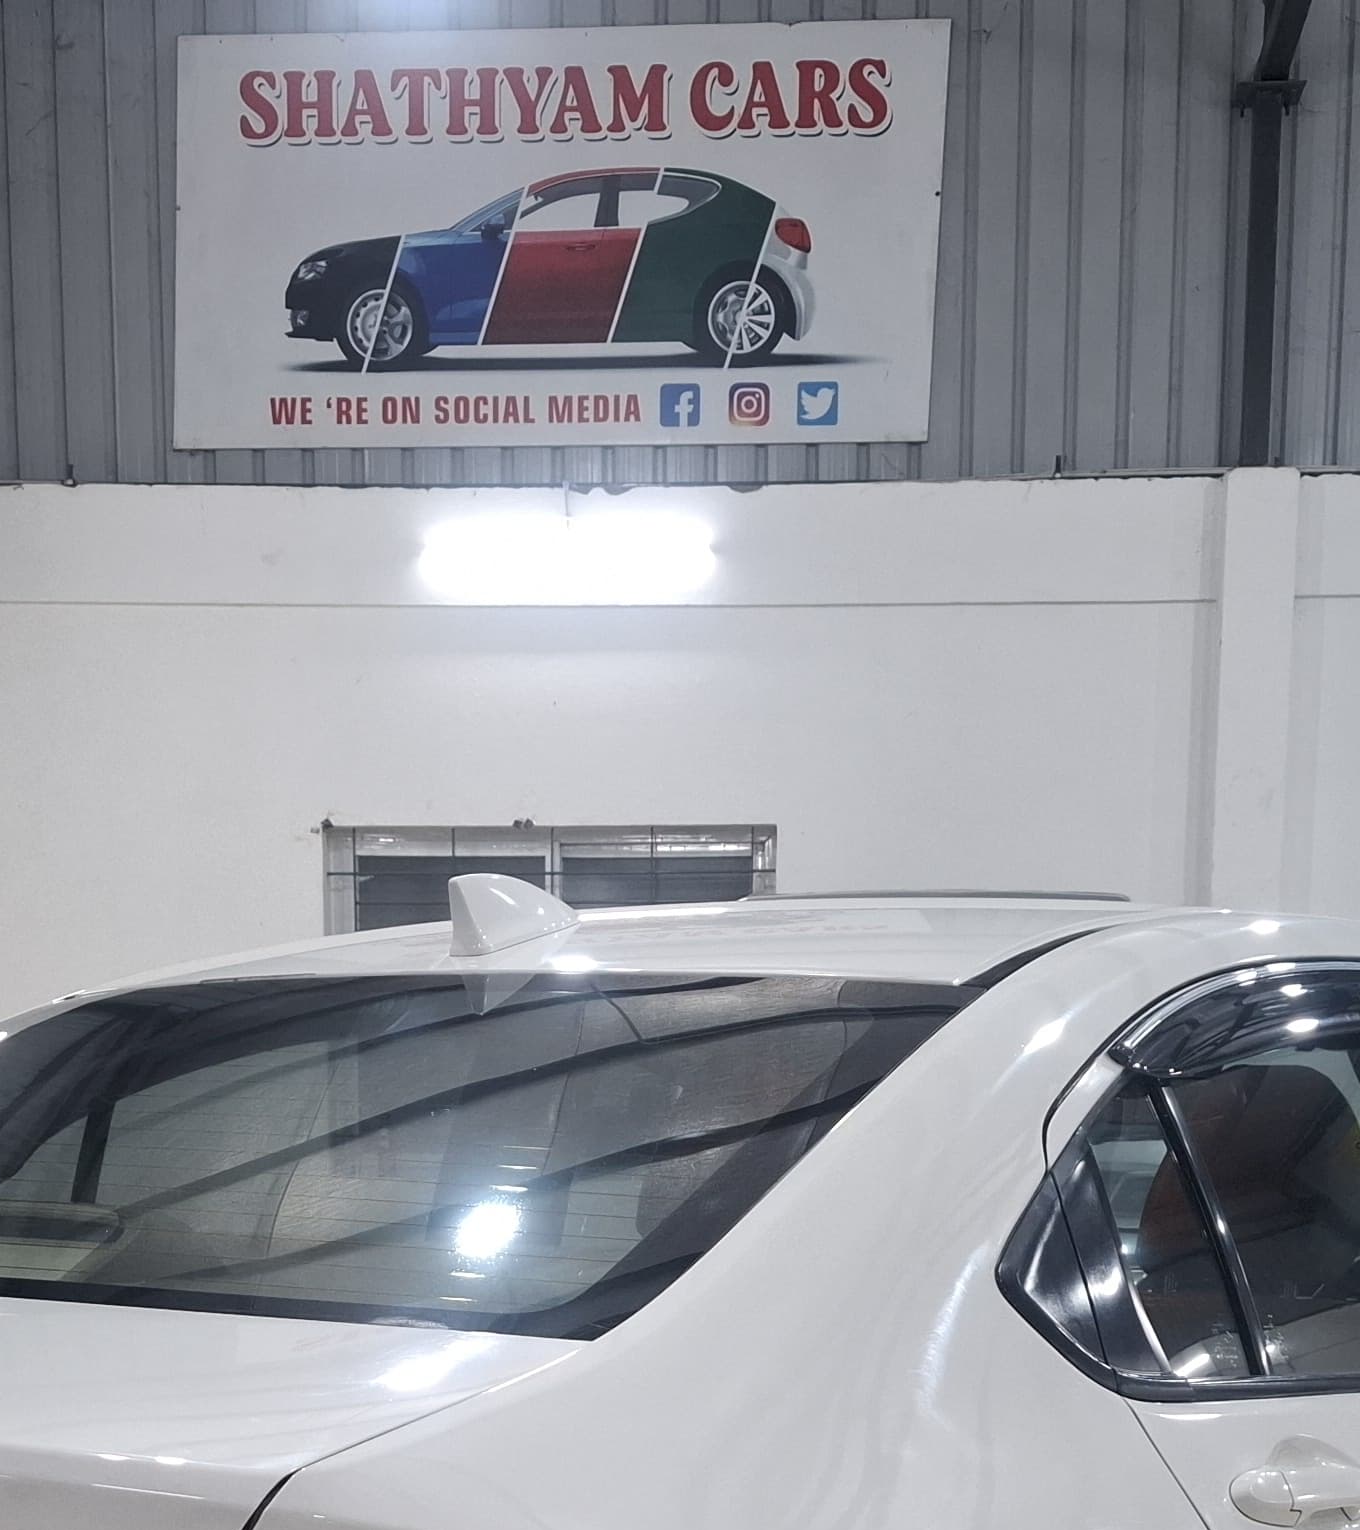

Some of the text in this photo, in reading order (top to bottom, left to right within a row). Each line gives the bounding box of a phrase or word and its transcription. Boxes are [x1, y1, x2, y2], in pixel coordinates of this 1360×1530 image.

[239, 57, 891, 146] SHATHYAM CARS
[269, 396, 313, 425] WE
[381, 395, 422, 424] ON
[433, 394, 538, 424] SOCIAL
[547, 393, 641, 423] MEDIA
